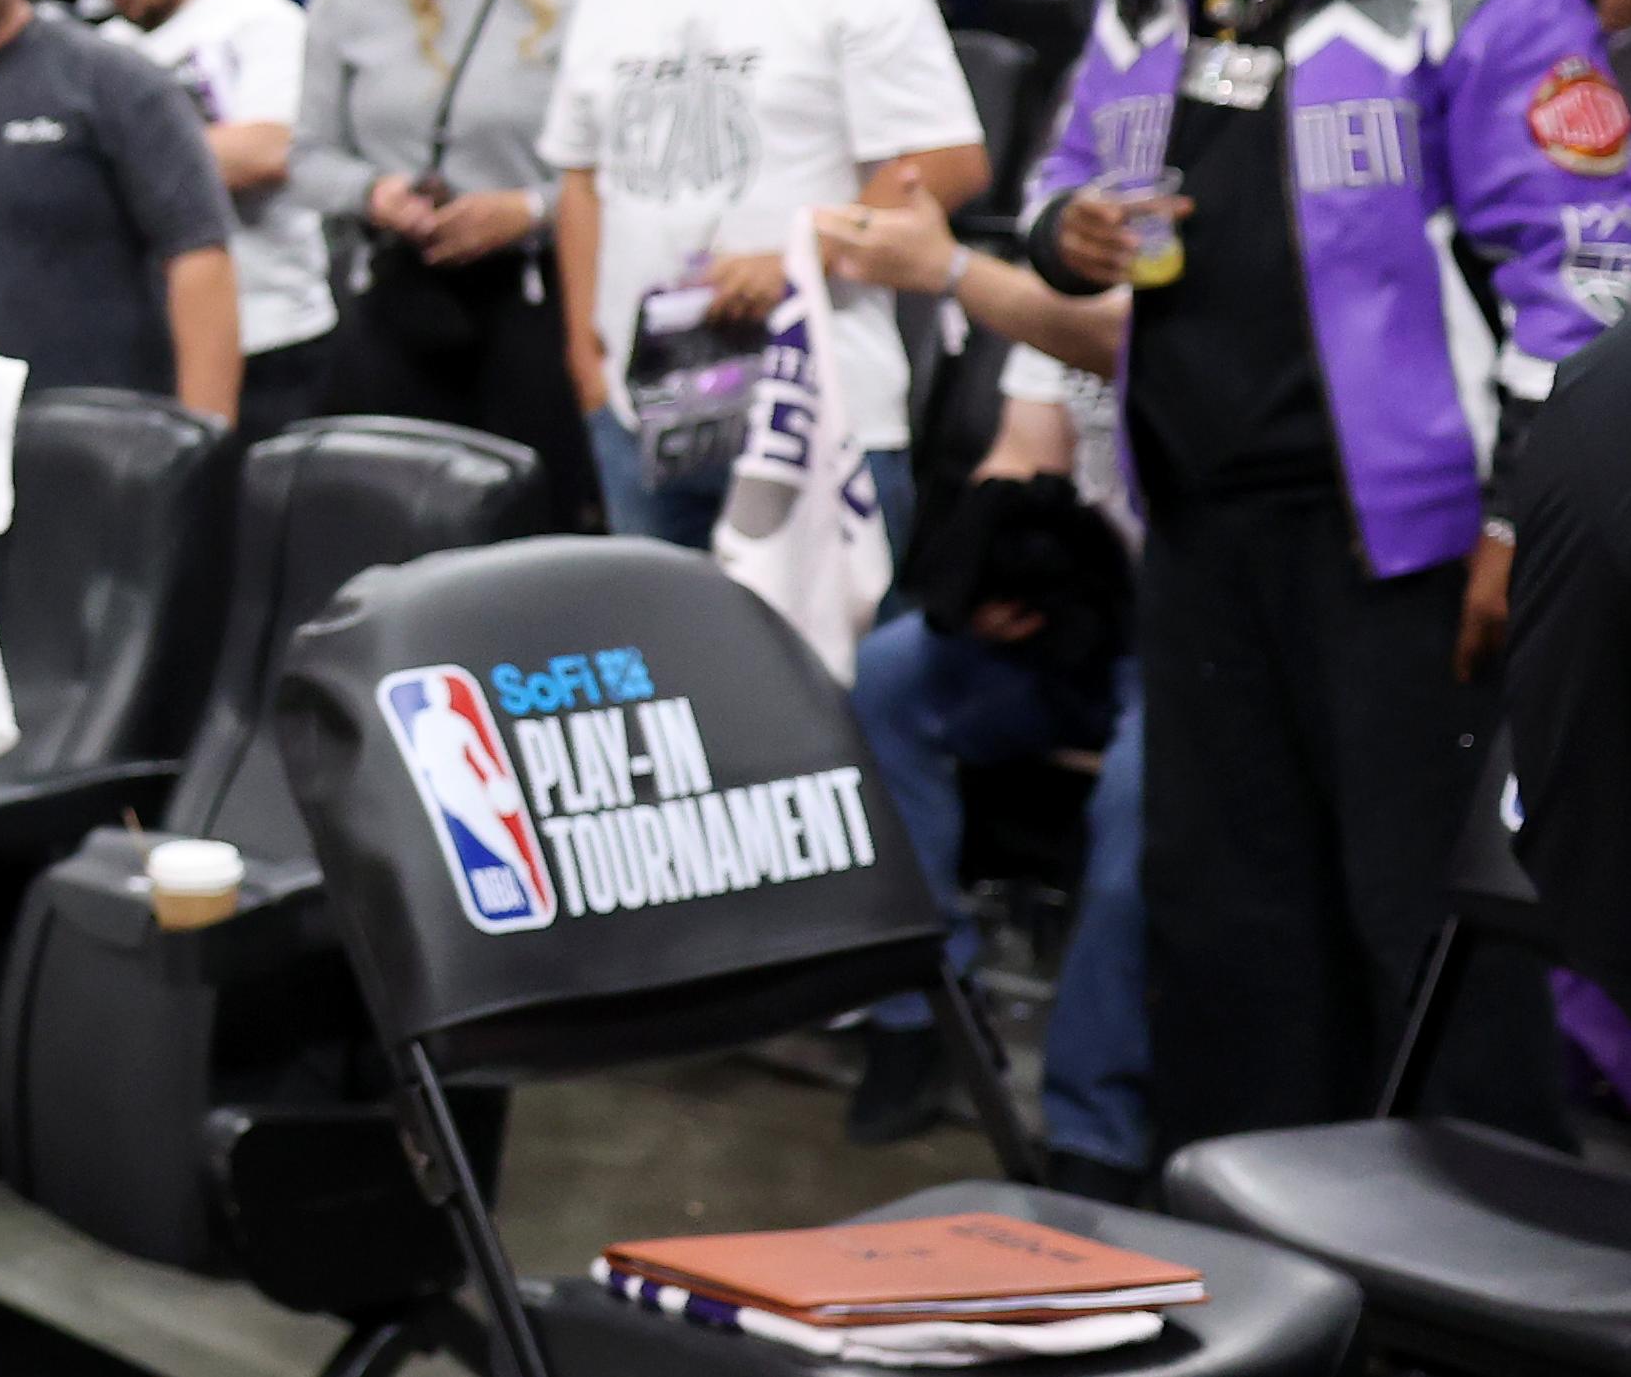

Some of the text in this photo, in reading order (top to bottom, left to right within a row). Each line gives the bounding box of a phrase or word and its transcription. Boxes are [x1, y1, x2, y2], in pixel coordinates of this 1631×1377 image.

[492, 654, 600, 715] SoFi
[515, 697, 712, 816] PLAY-IN
[541, 767, 876, 917] TOURNAMENT
